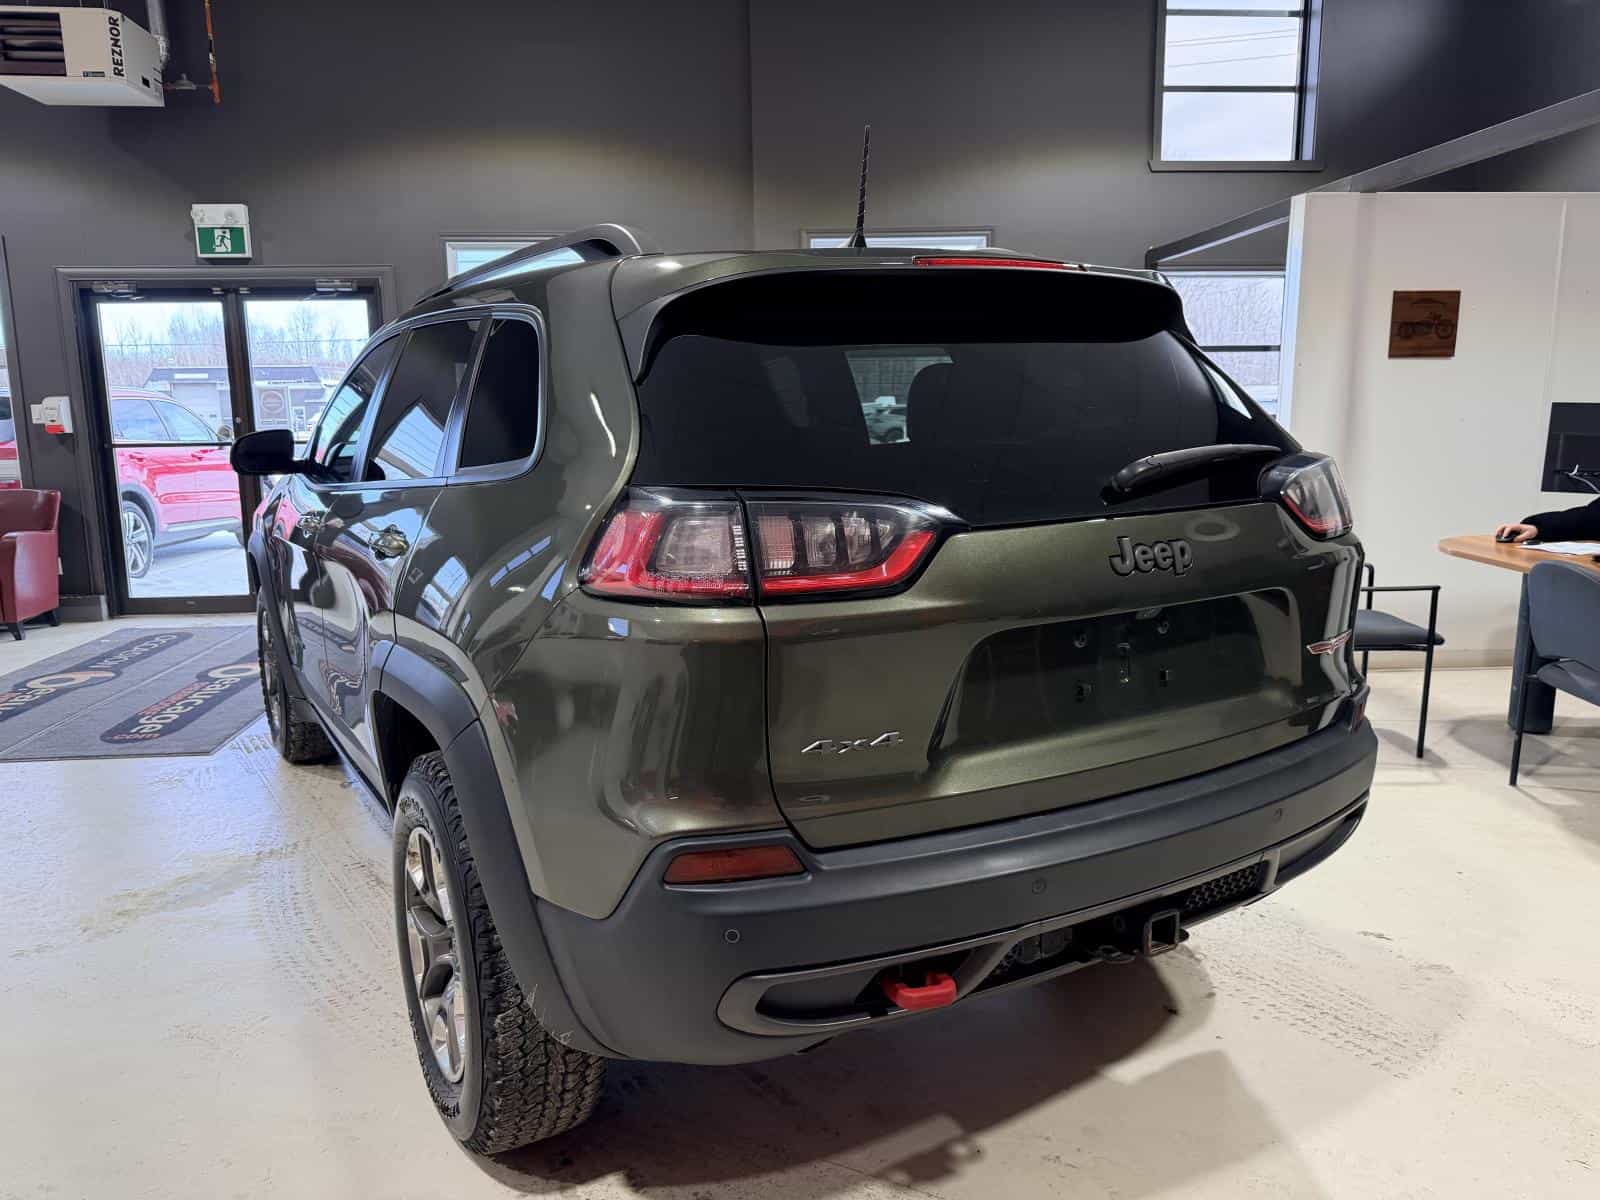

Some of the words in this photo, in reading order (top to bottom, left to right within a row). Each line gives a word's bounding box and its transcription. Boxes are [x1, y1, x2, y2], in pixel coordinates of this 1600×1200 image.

[108, 16, 125, 77] REZNOR
[1108, 536, 1193, 576] Jeep
[800, 731, 904, 754] 4x4
